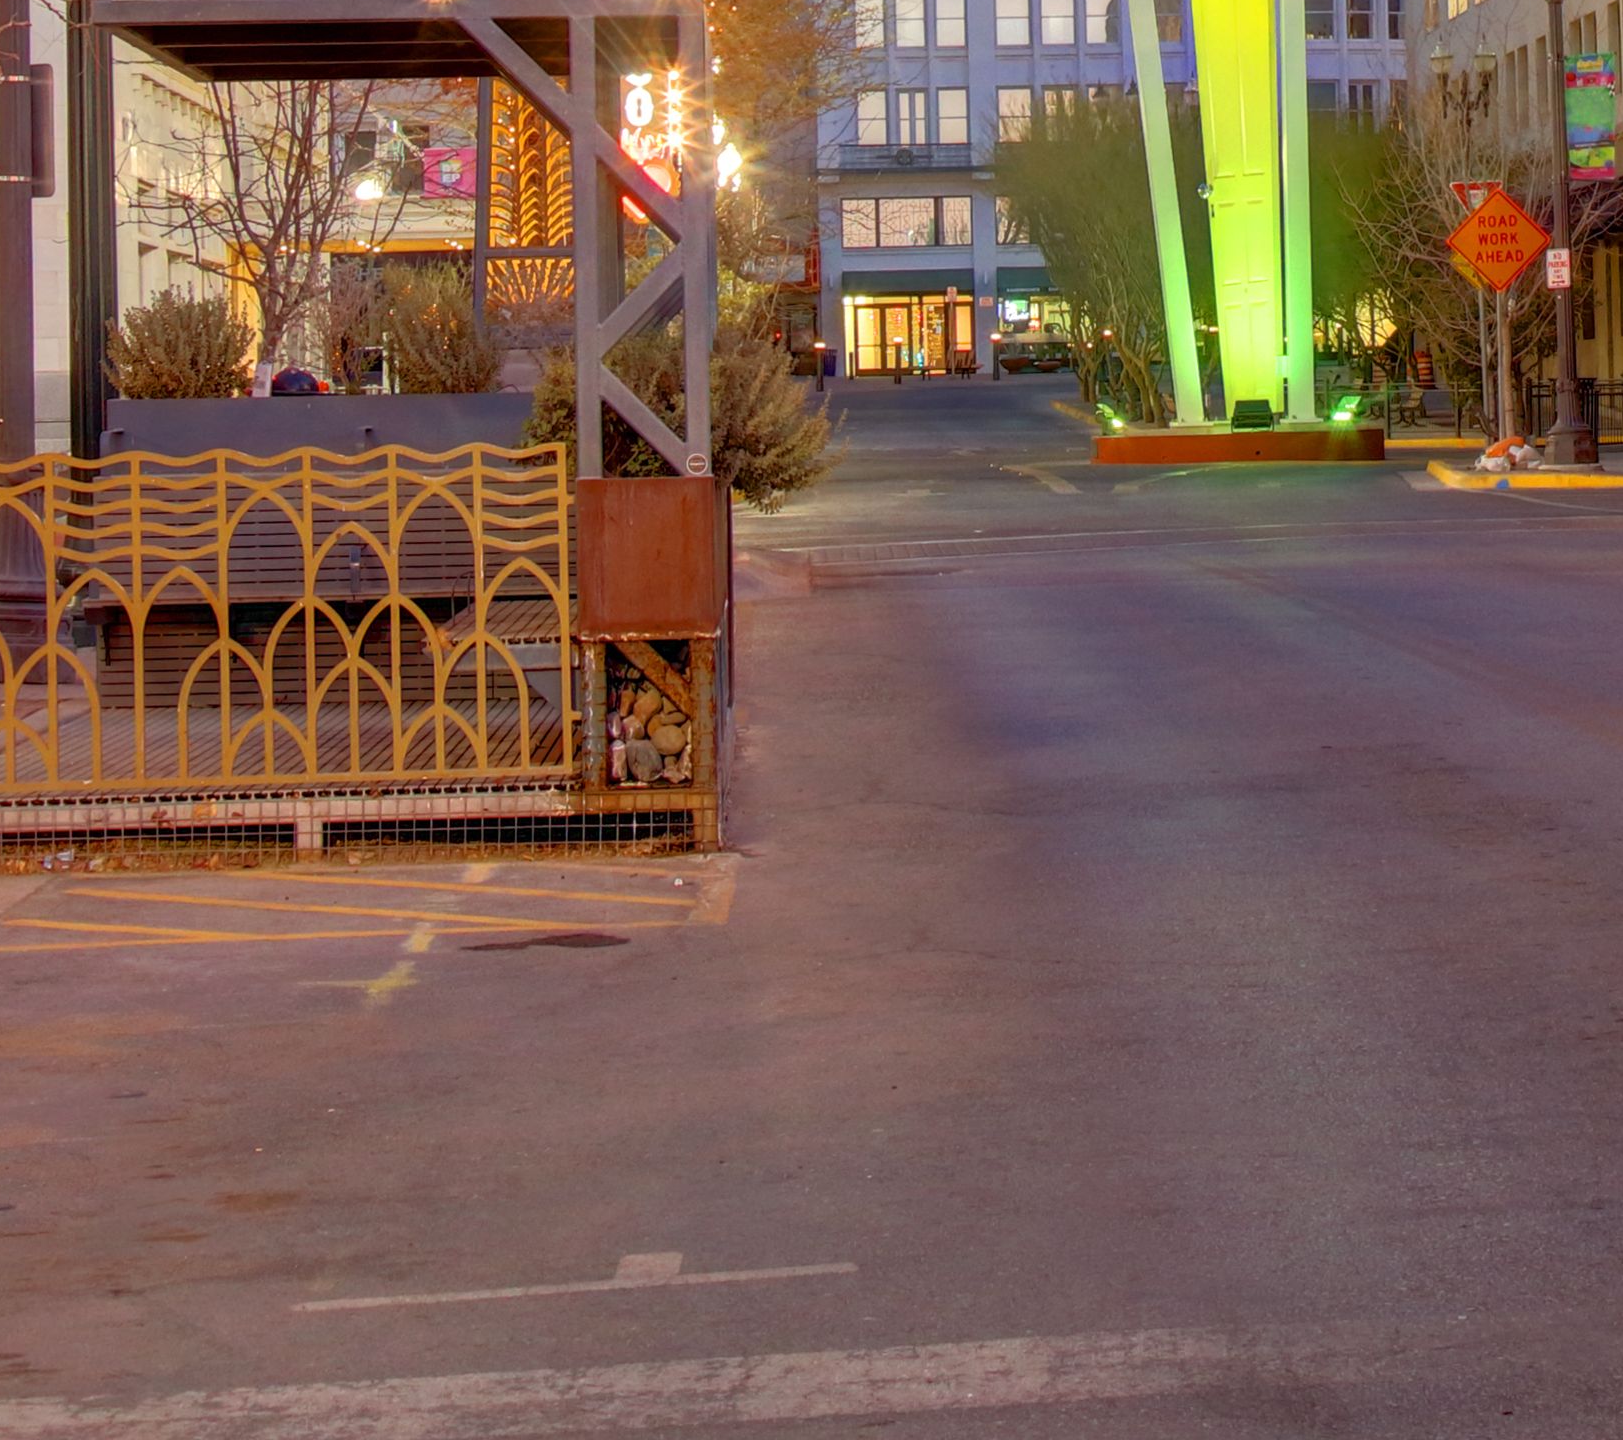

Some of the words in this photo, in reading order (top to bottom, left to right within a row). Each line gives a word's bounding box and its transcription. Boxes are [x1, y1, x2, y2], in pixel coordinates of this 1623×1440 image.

[1478, 214, 1518, 228] ROAD
[1478, 232, 1519, 246] WORK
[1475, 249, 1525, 263] AHEAD
